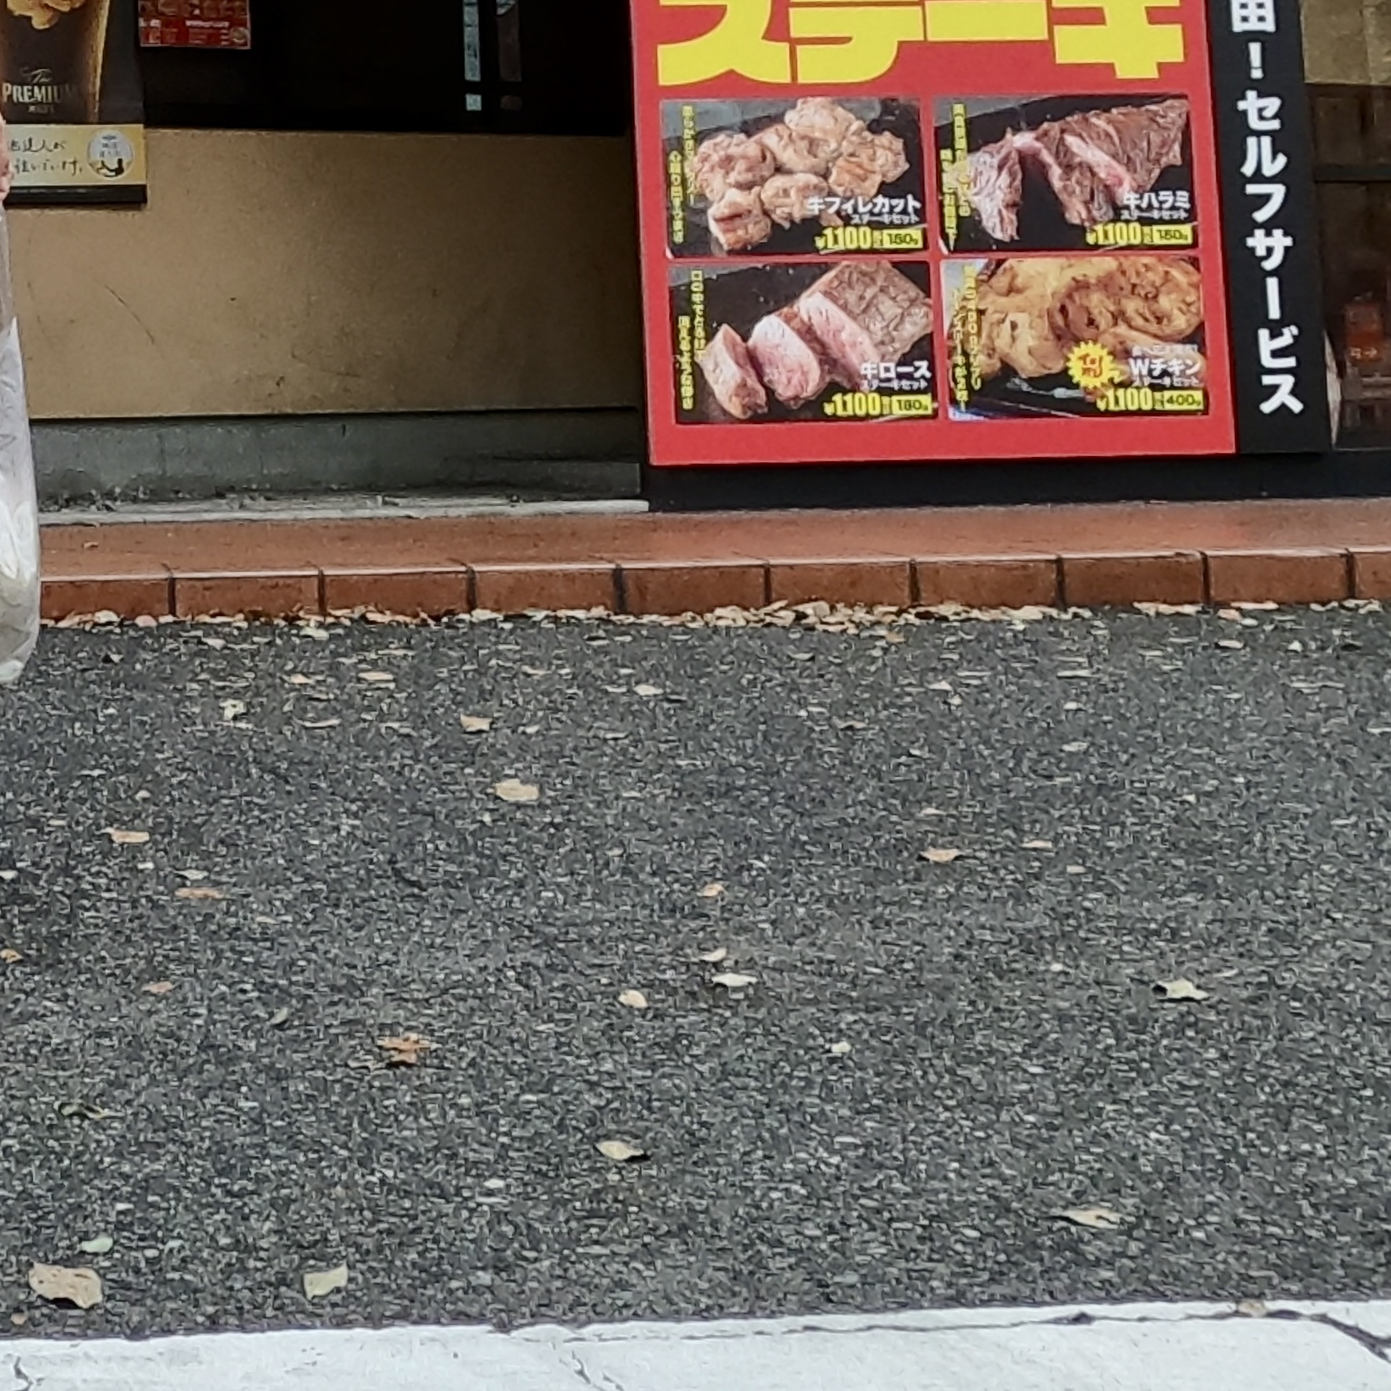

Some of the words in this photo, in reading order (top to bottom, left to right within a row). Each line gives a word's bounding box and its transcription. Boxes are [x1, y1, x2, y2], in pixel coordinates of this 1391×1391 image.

[1123, 190, 1191, 210] 牛ハラミ
[860, 361, 932, 379] 牛ロース
[1129, 358, 1201, 376] Wチキン
